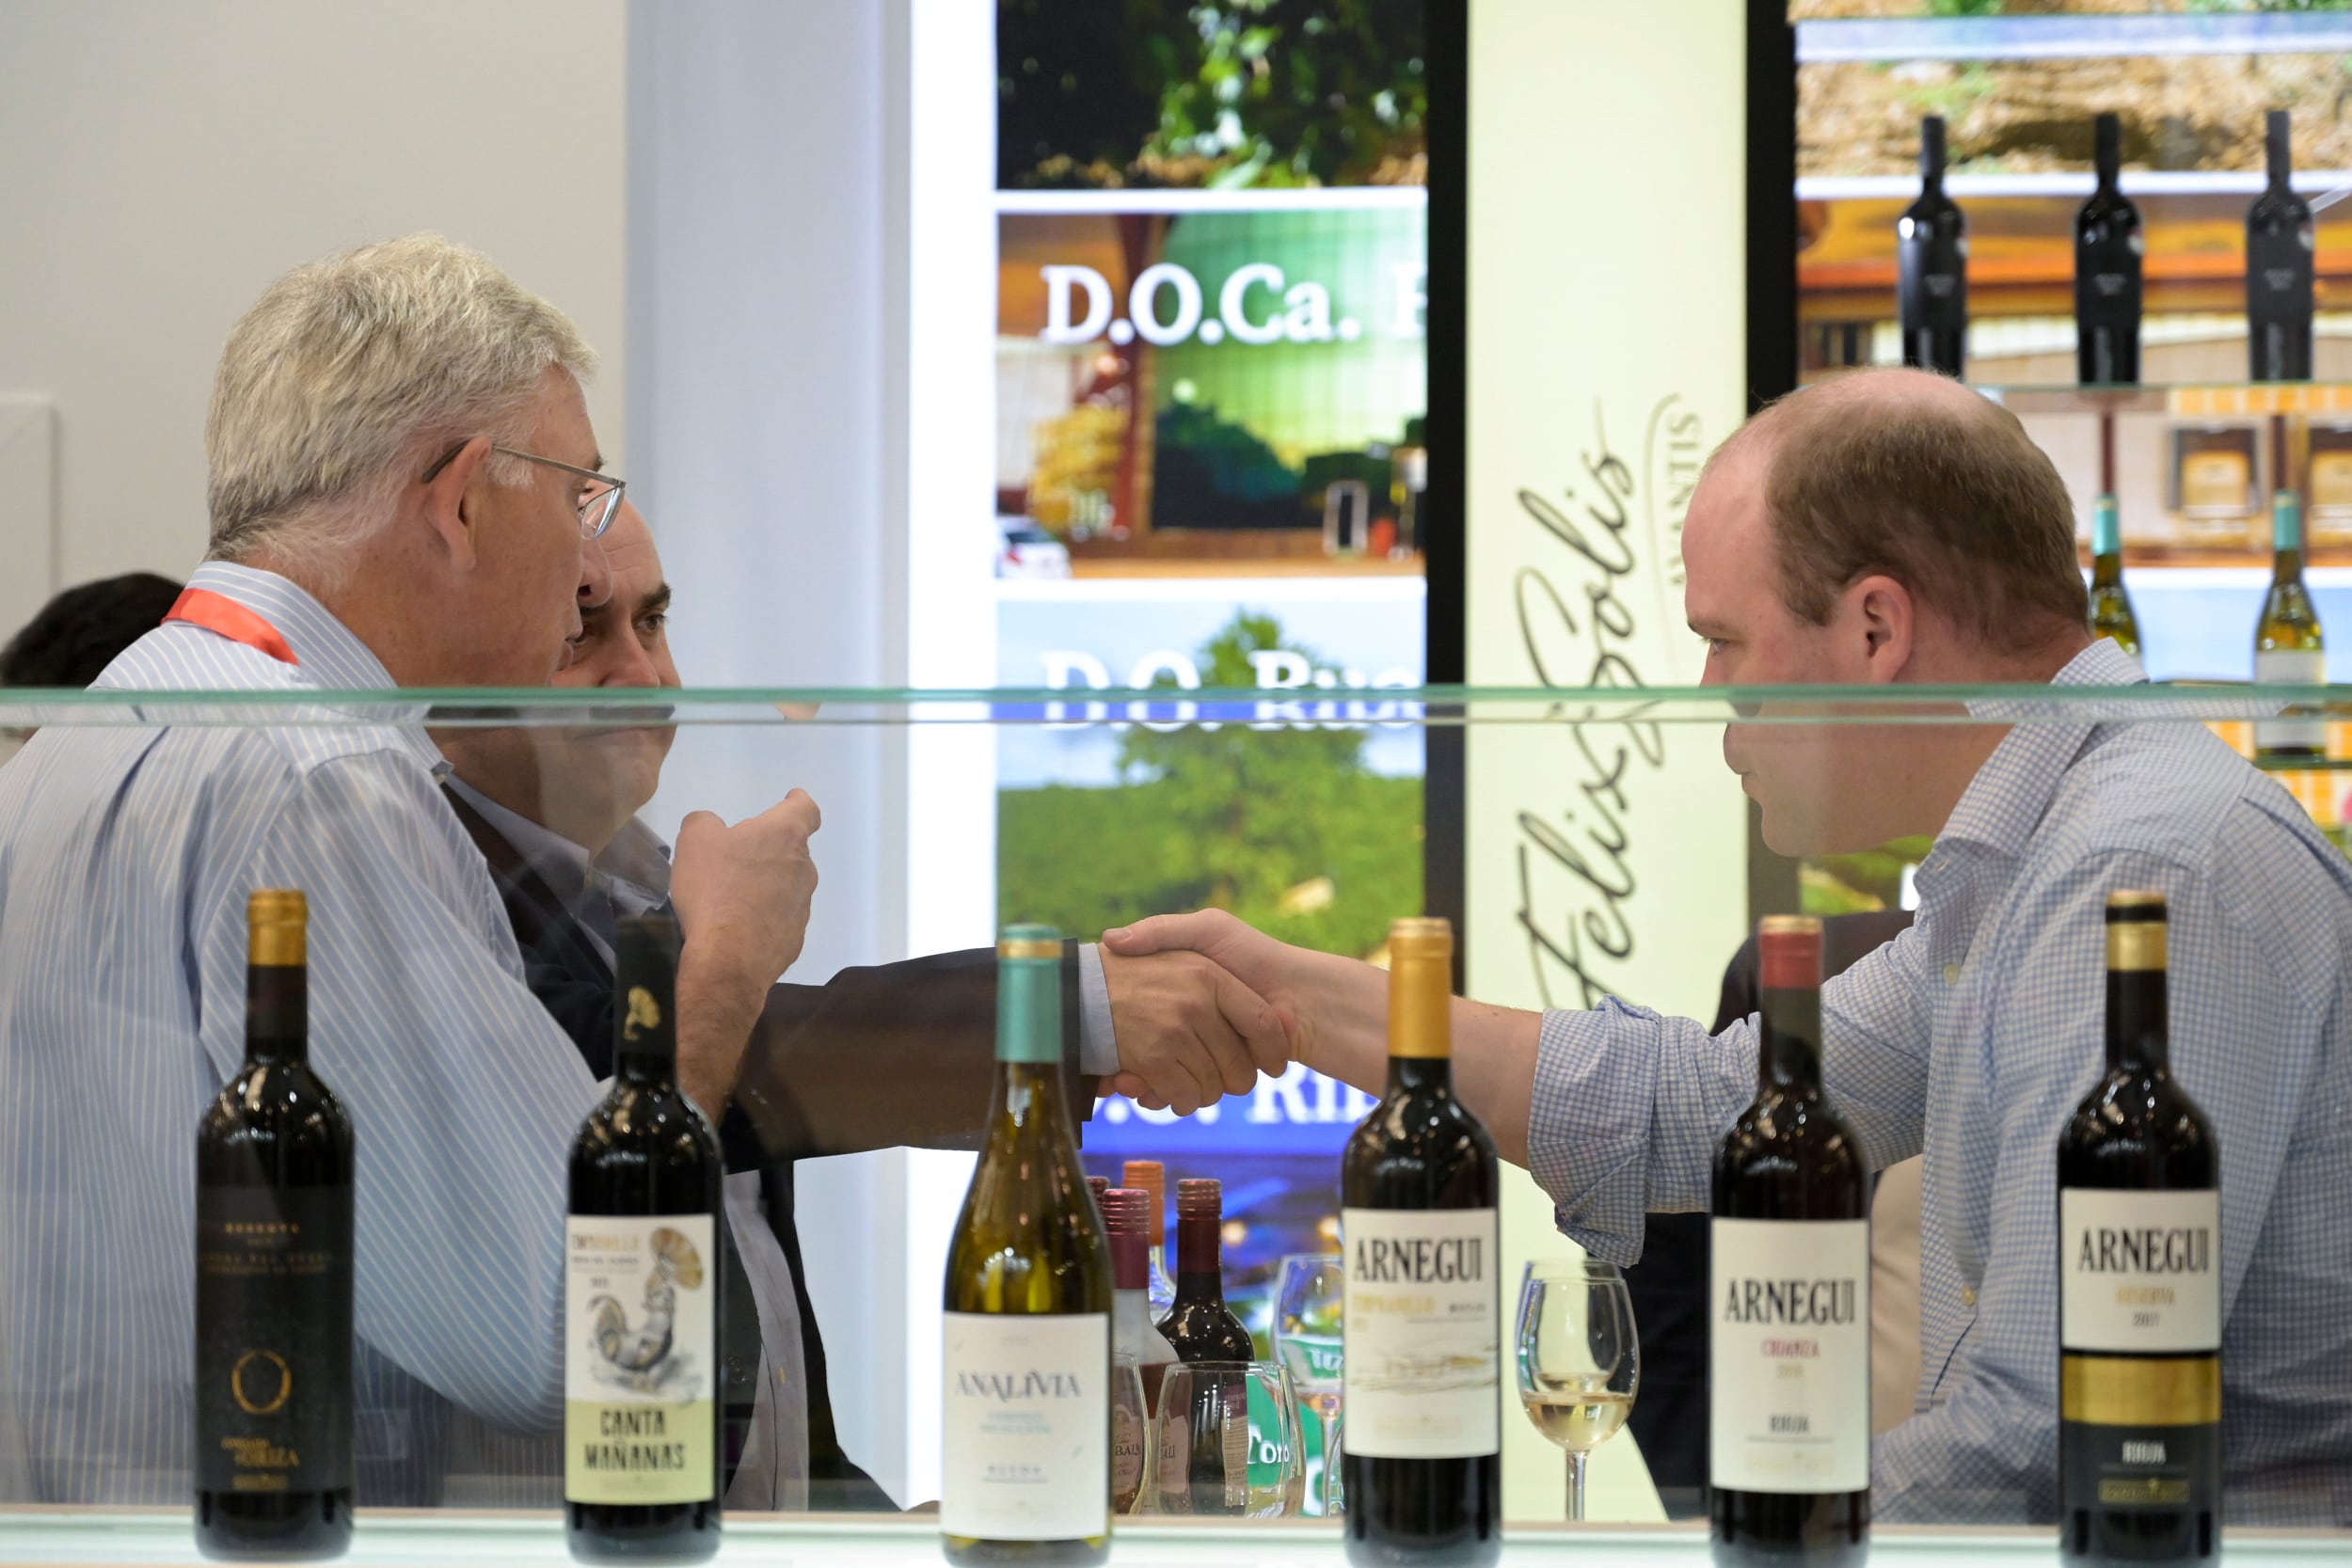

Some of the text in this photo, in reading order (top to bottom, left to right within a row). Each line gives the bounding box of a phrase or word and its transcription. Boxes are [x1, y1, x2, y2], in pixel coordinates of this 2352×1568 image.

[1039, 262, 1361, 345] D.O.Ca.
[1353, 1236, 1484, 1283] ARNEGUI
[2077, 1226, 2210, 1275] ARNEGUI
[1724, 1278, 1856, 1325] ARNEGUI
[599, 1408, 667, 1437] CANTA
[583, 1438, 686, 1471] MAÑANAS
